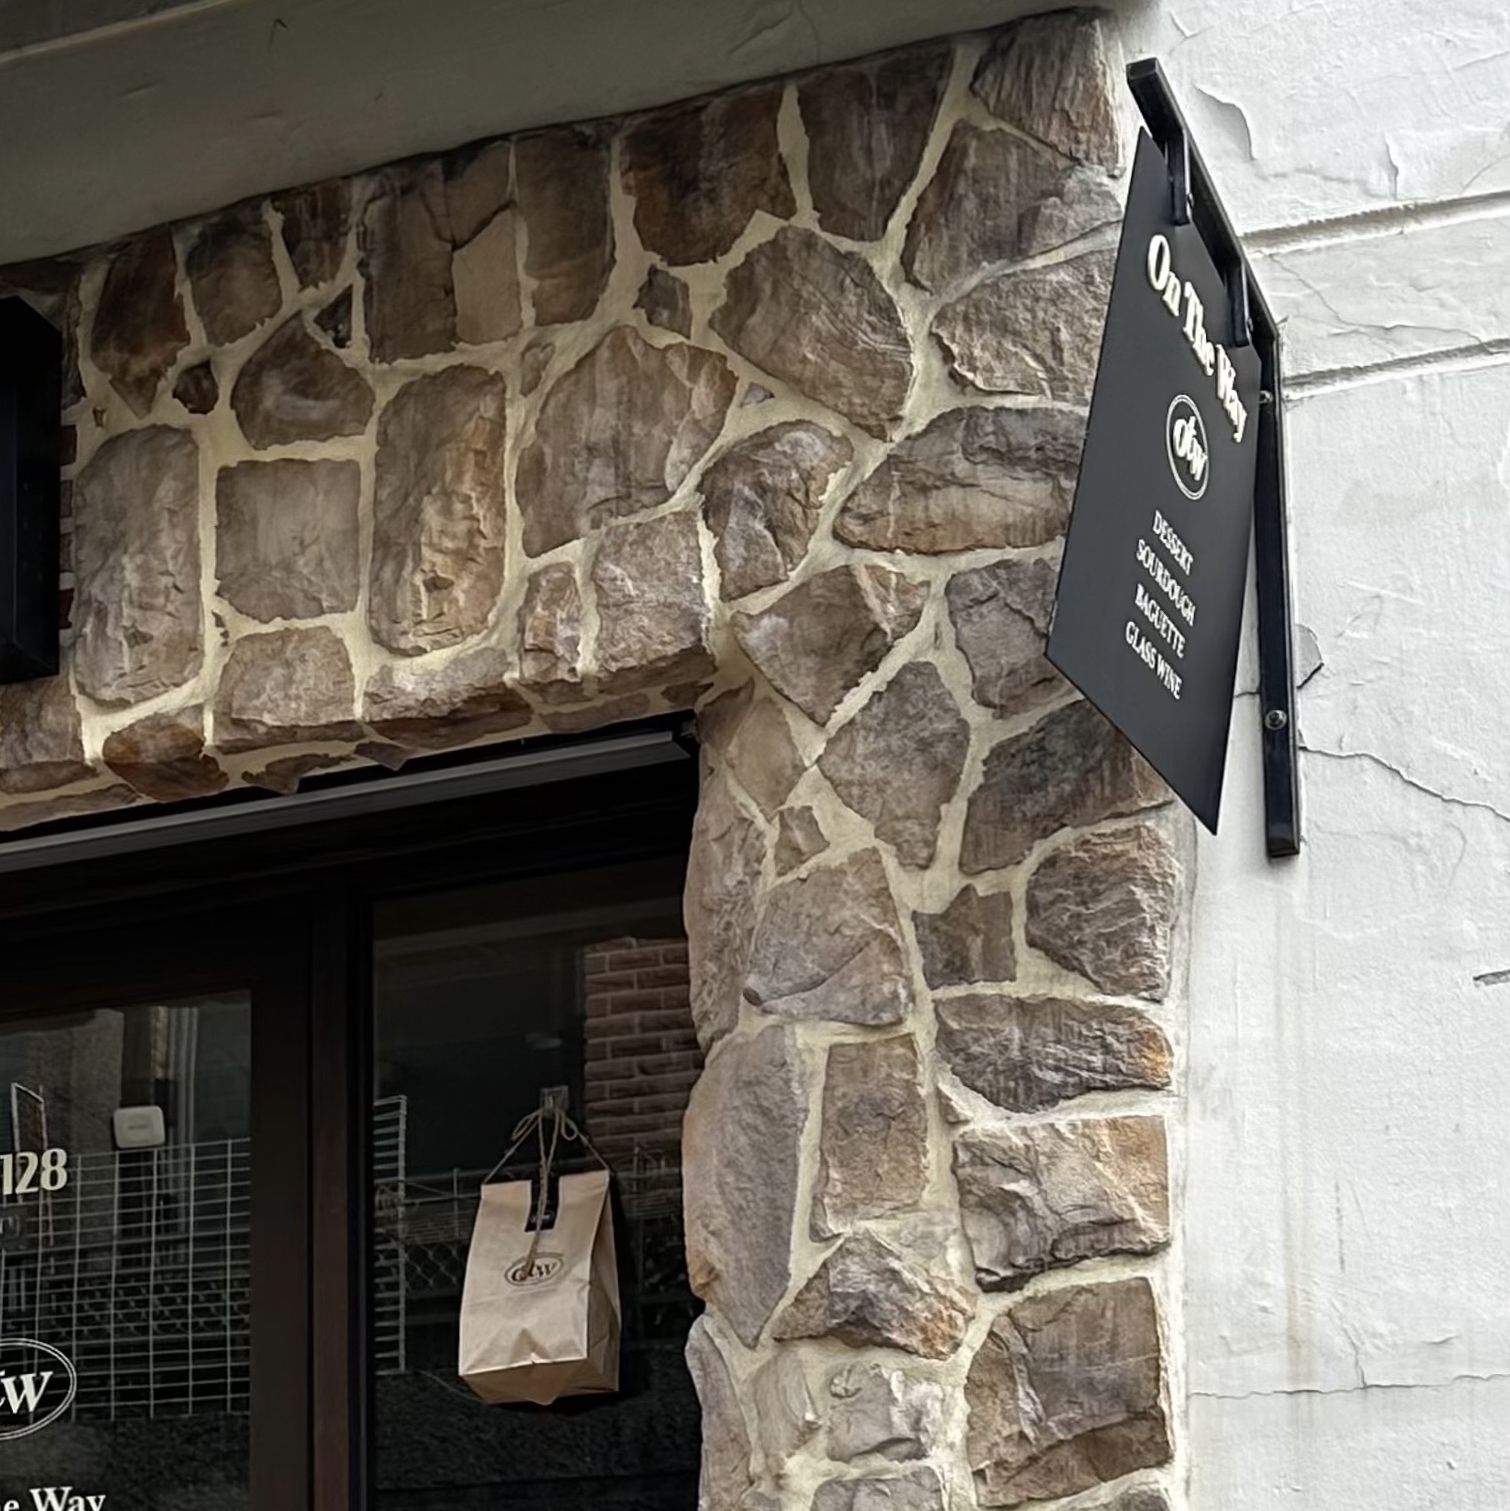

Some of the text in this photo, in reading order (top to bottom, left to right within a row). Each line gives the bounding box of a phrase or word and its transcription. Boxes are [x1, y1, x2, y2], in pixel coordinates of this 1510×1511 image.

[1147, 234, 1248, 443] On The Way
[1172, 415, 1208, 481] otw
[1152, 509, 1194, 576] DESSERT
[1134, 583, 1186, 659] BAGUETTE
[1136, 538, 1196, 627] SOURDOUGH
[1125, 620, 1183, 700] GLASS WINE
